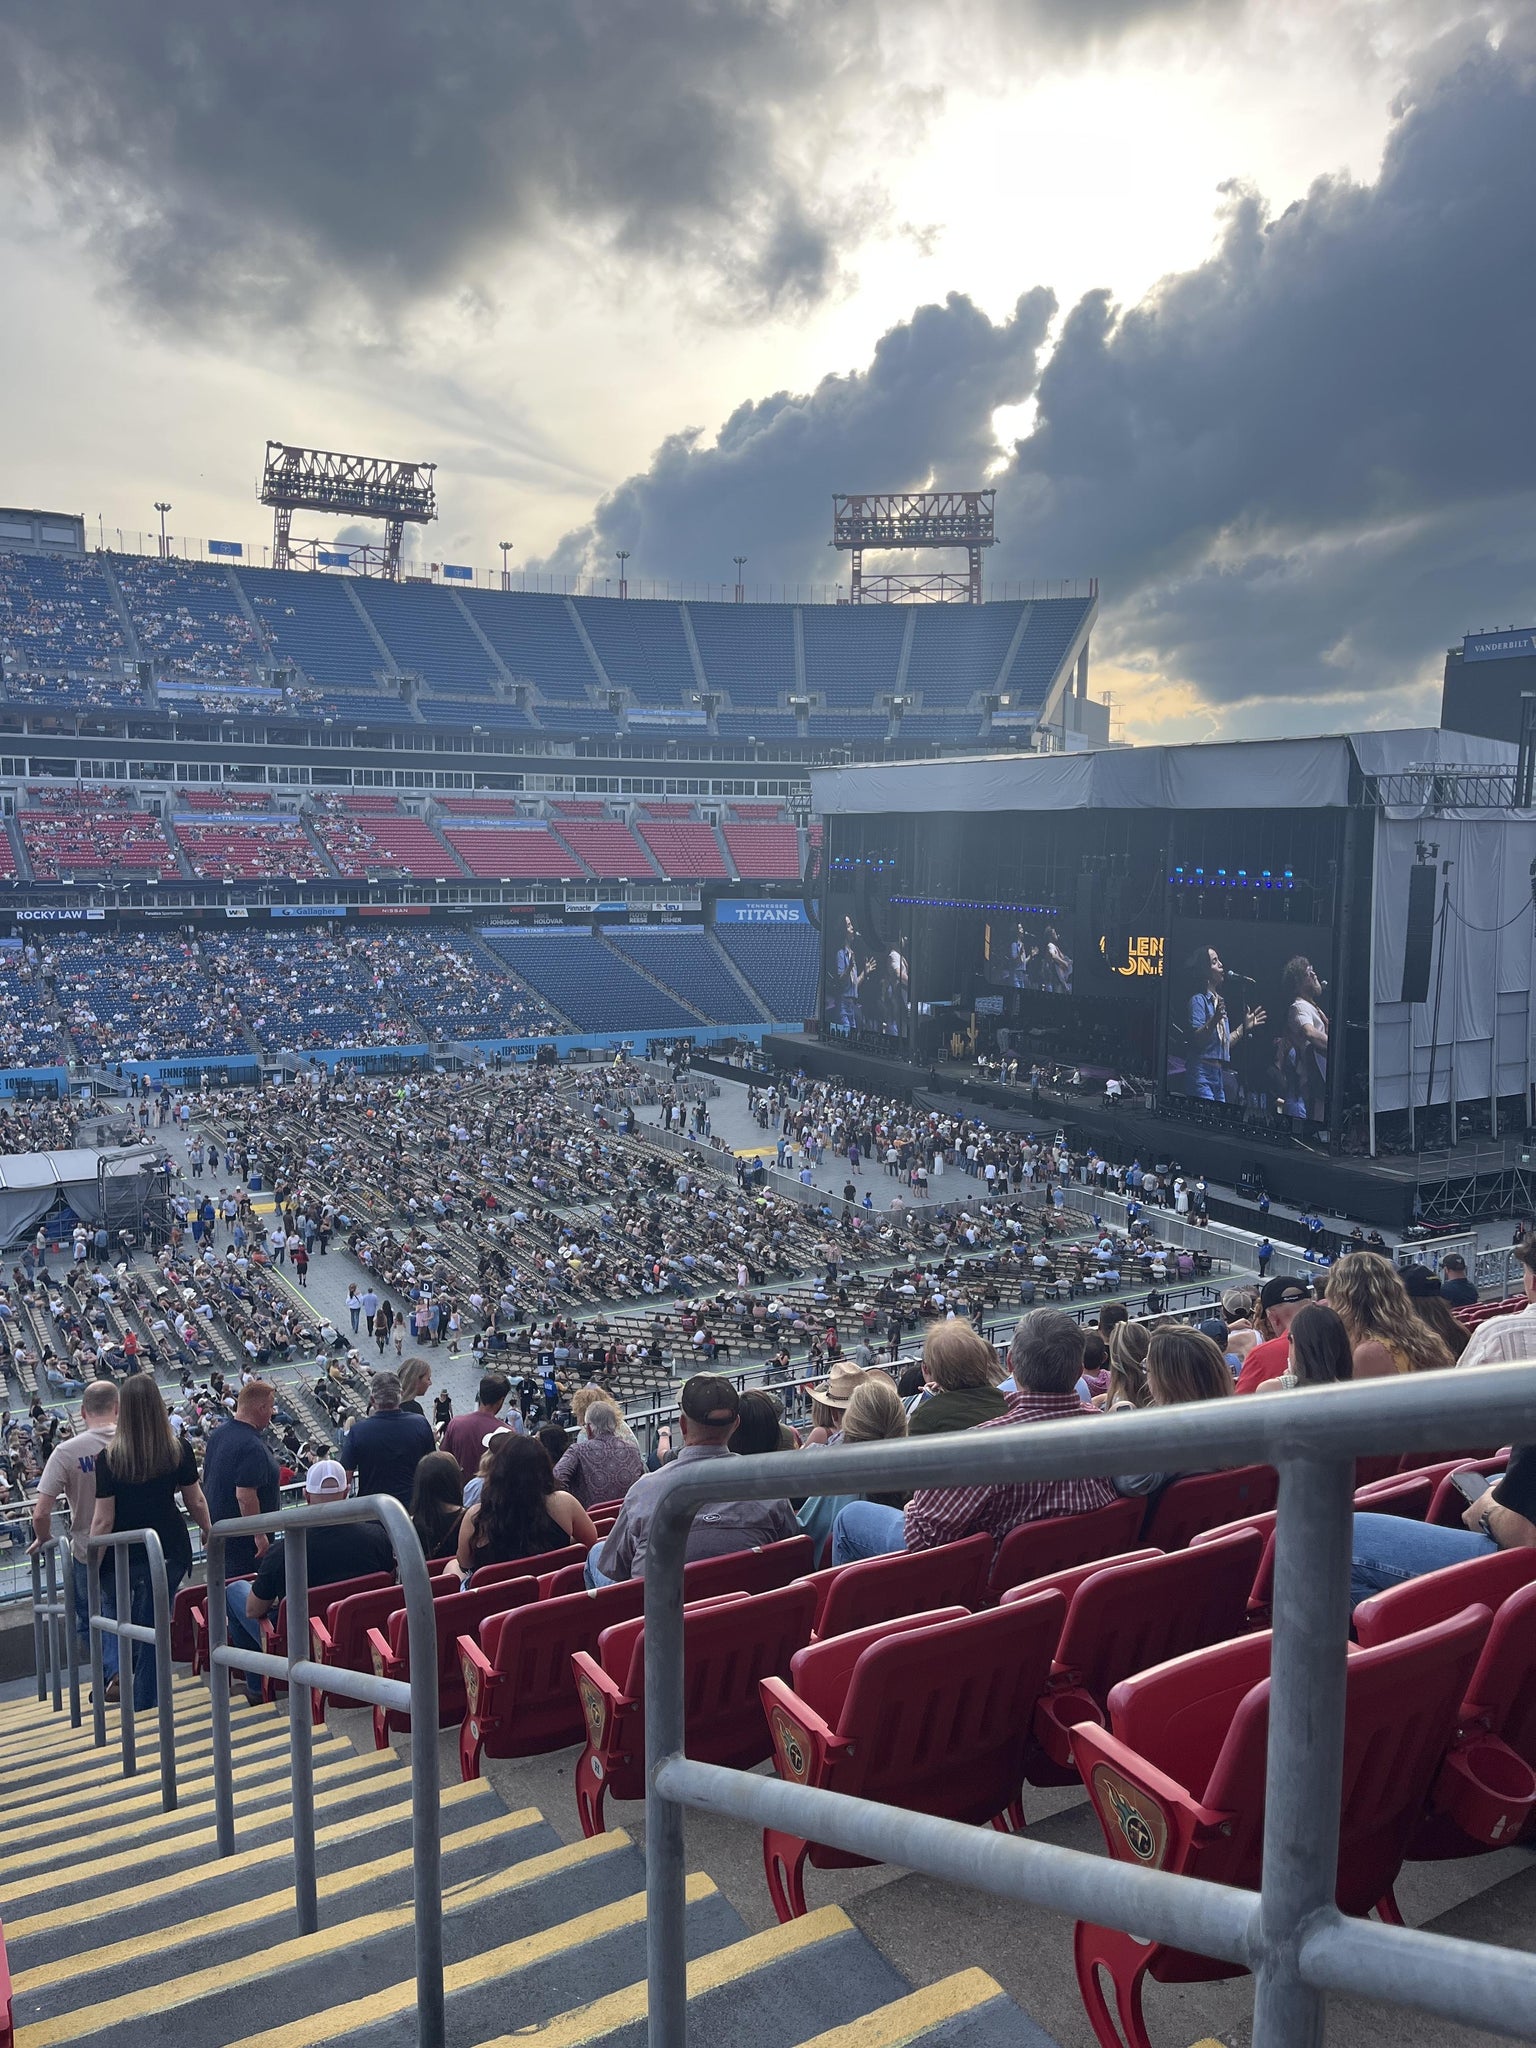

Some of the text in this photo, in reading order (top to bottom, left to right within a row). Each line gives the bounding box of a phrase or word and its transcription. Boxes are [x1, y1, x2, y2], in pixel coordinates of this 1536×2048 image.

[1475, 640, 1529, 653] VANDERBILT
[296, 907, 336, 915] Gallagher
[566, 904, 592, 912] Pinnacle
[16, 911, 82, 920] ROCKY LAW
[735, 909, 800, 921] TITANS
[159, 1065, 200, 1079] TENNESSEE
[423, 1283, 430, 1291] D
[542, 1356, 549, 1365] E
